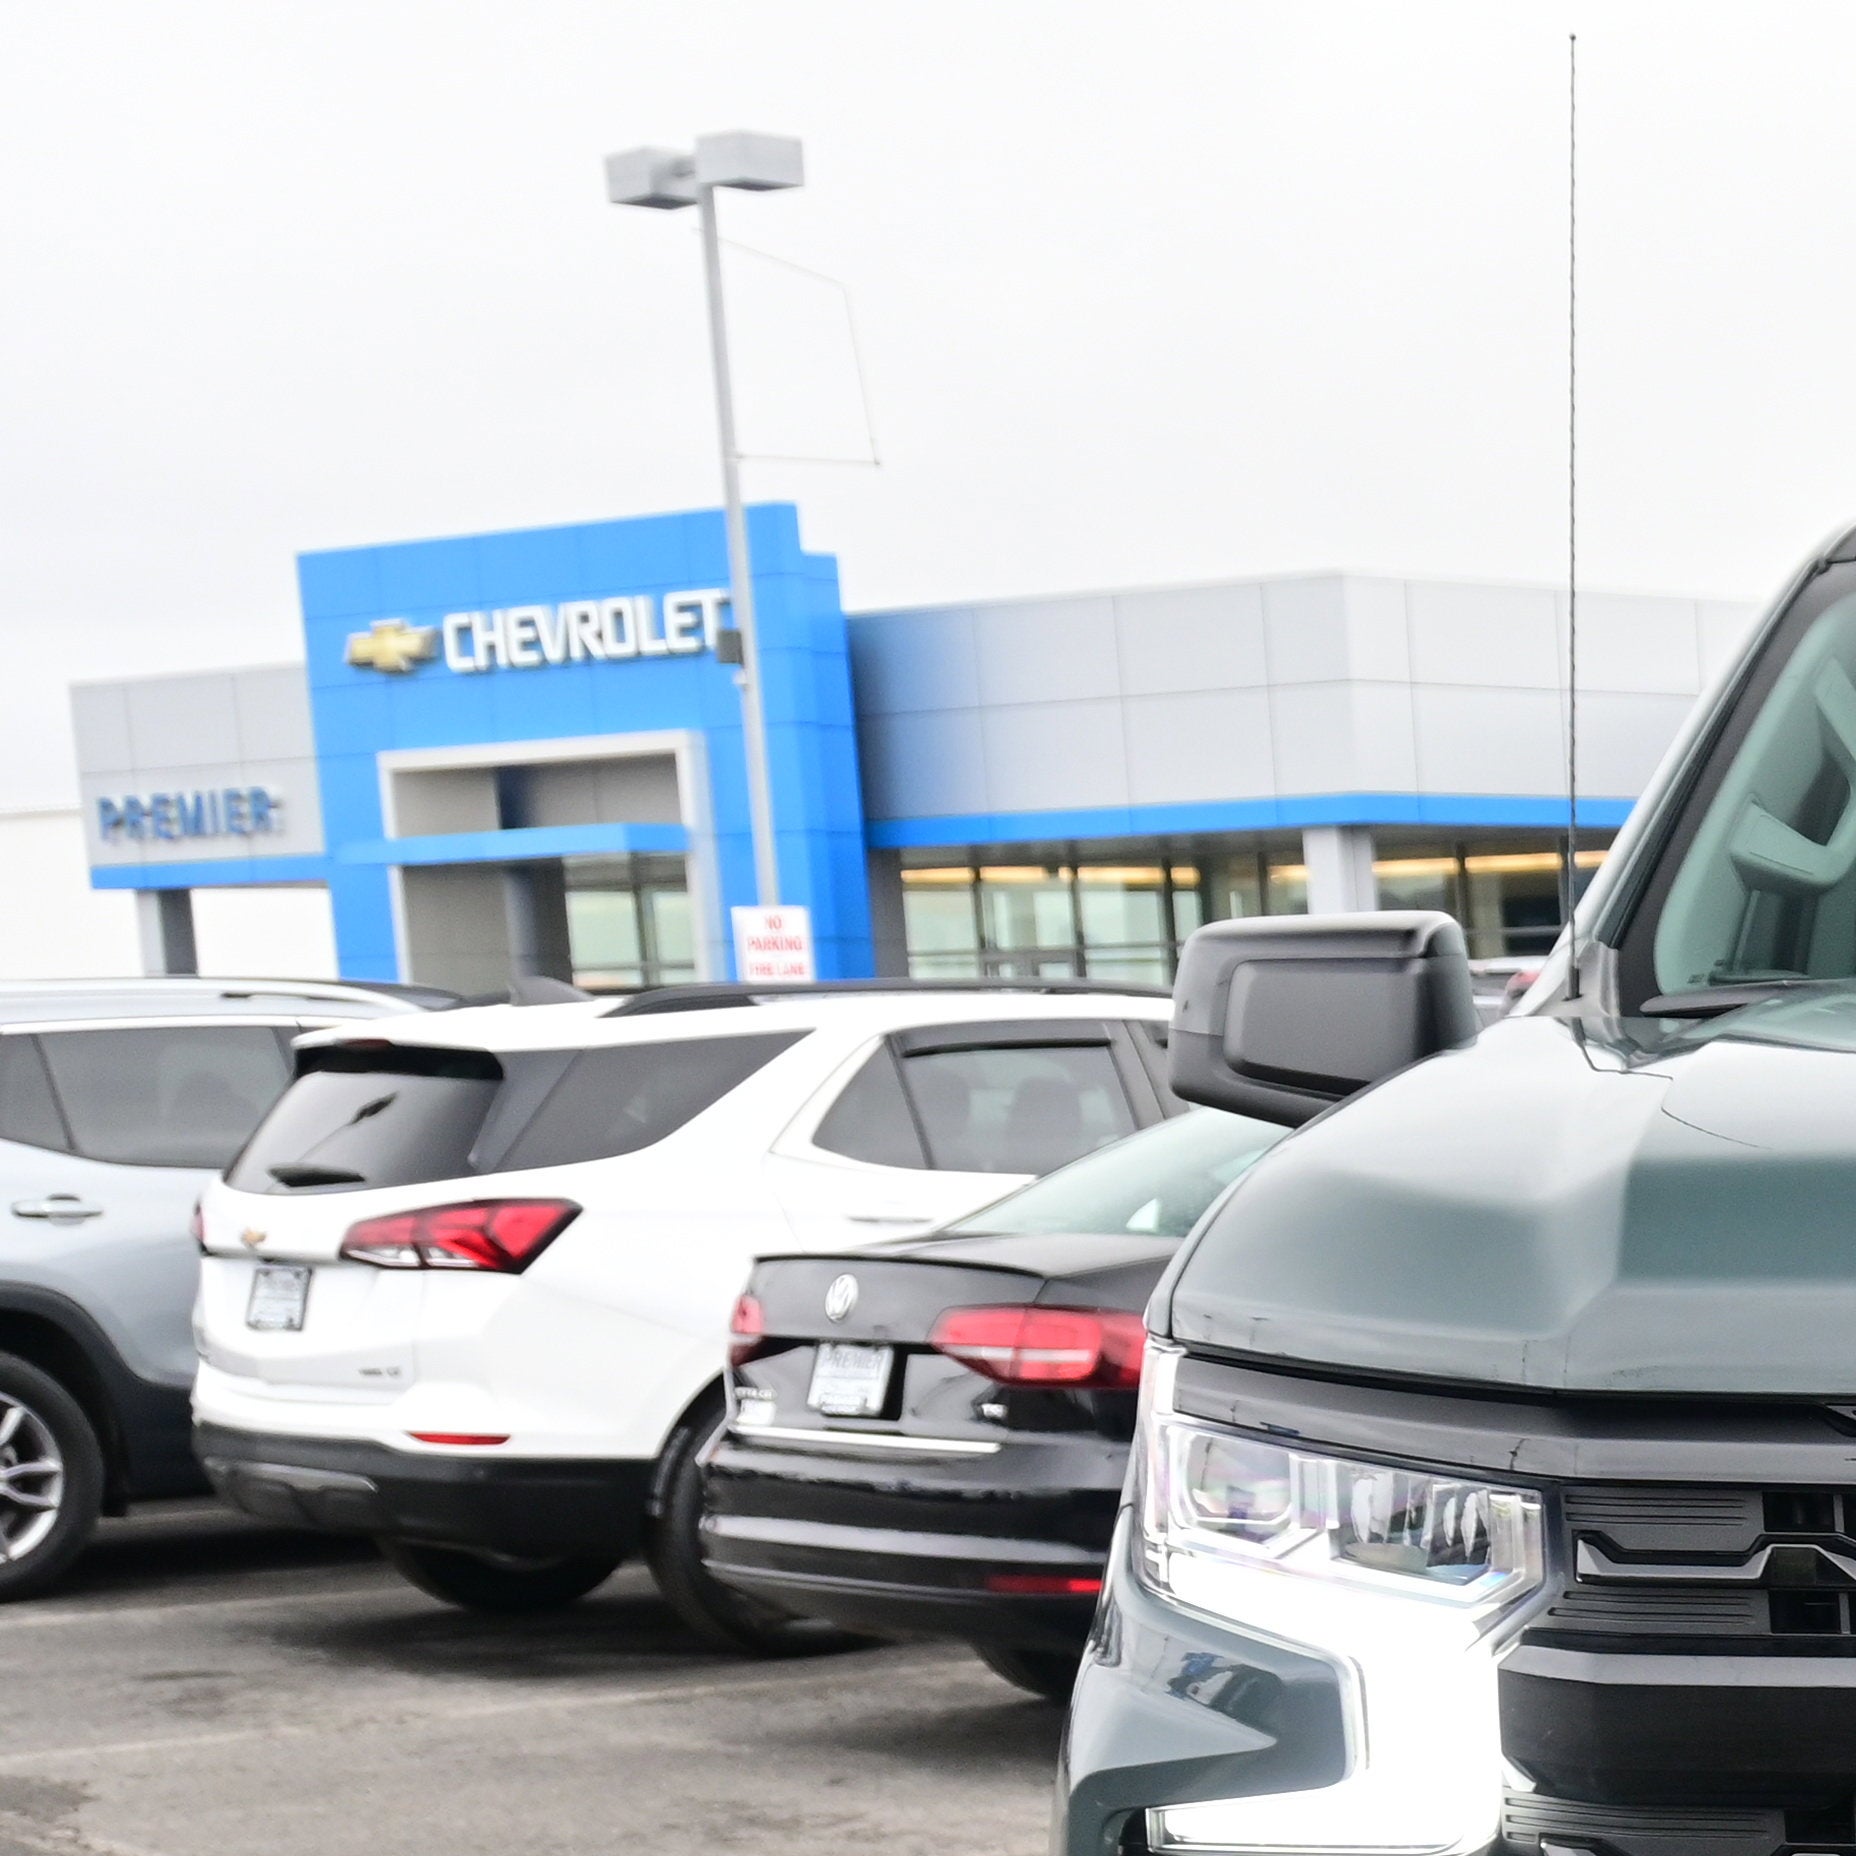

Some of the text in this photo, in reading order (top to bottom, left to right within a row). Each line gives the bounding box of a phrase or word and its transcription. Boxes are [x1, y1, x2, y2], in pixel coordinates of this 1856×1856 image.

[443, 588, 731, 672] CHEVROLET
[97, 786, 275, 841] PREMIER
[747, 935, 802, 952] PARKING
